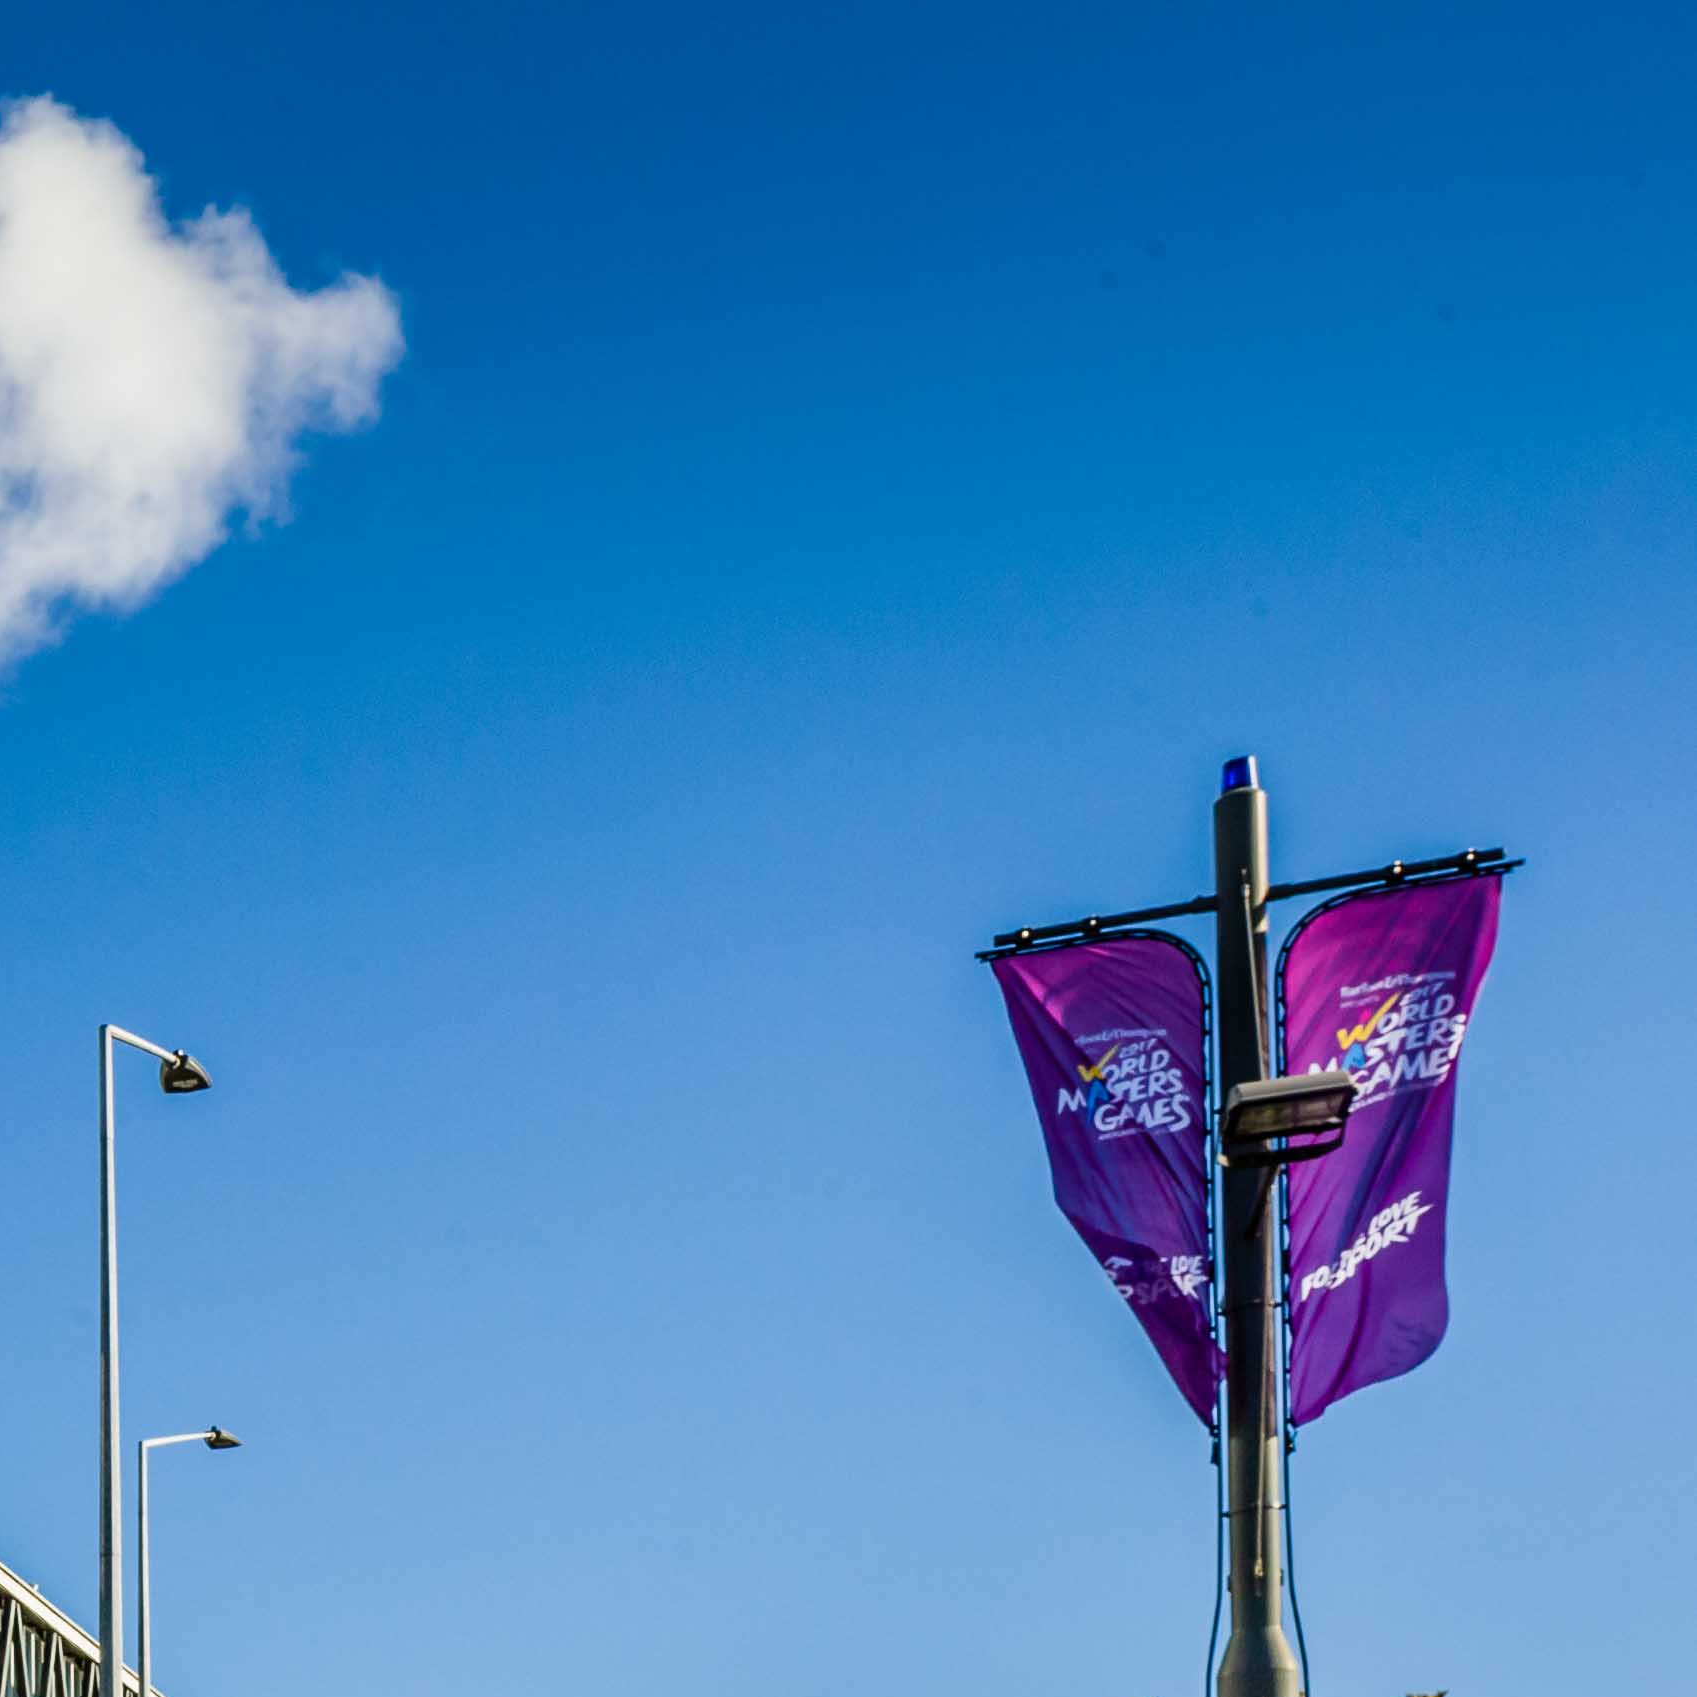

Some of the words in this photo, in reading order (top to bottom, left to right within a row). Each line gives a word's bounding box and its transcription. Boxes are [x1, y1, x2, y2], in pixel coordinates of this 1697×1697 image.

[1337, 988, 1454, 1050] WORLD
[1077, 1044, 1170, 1082] WORLD
[1058, 1068, 1184, 1122] MASTERS
[1094, 1094, 1191, 1132] GAMES
